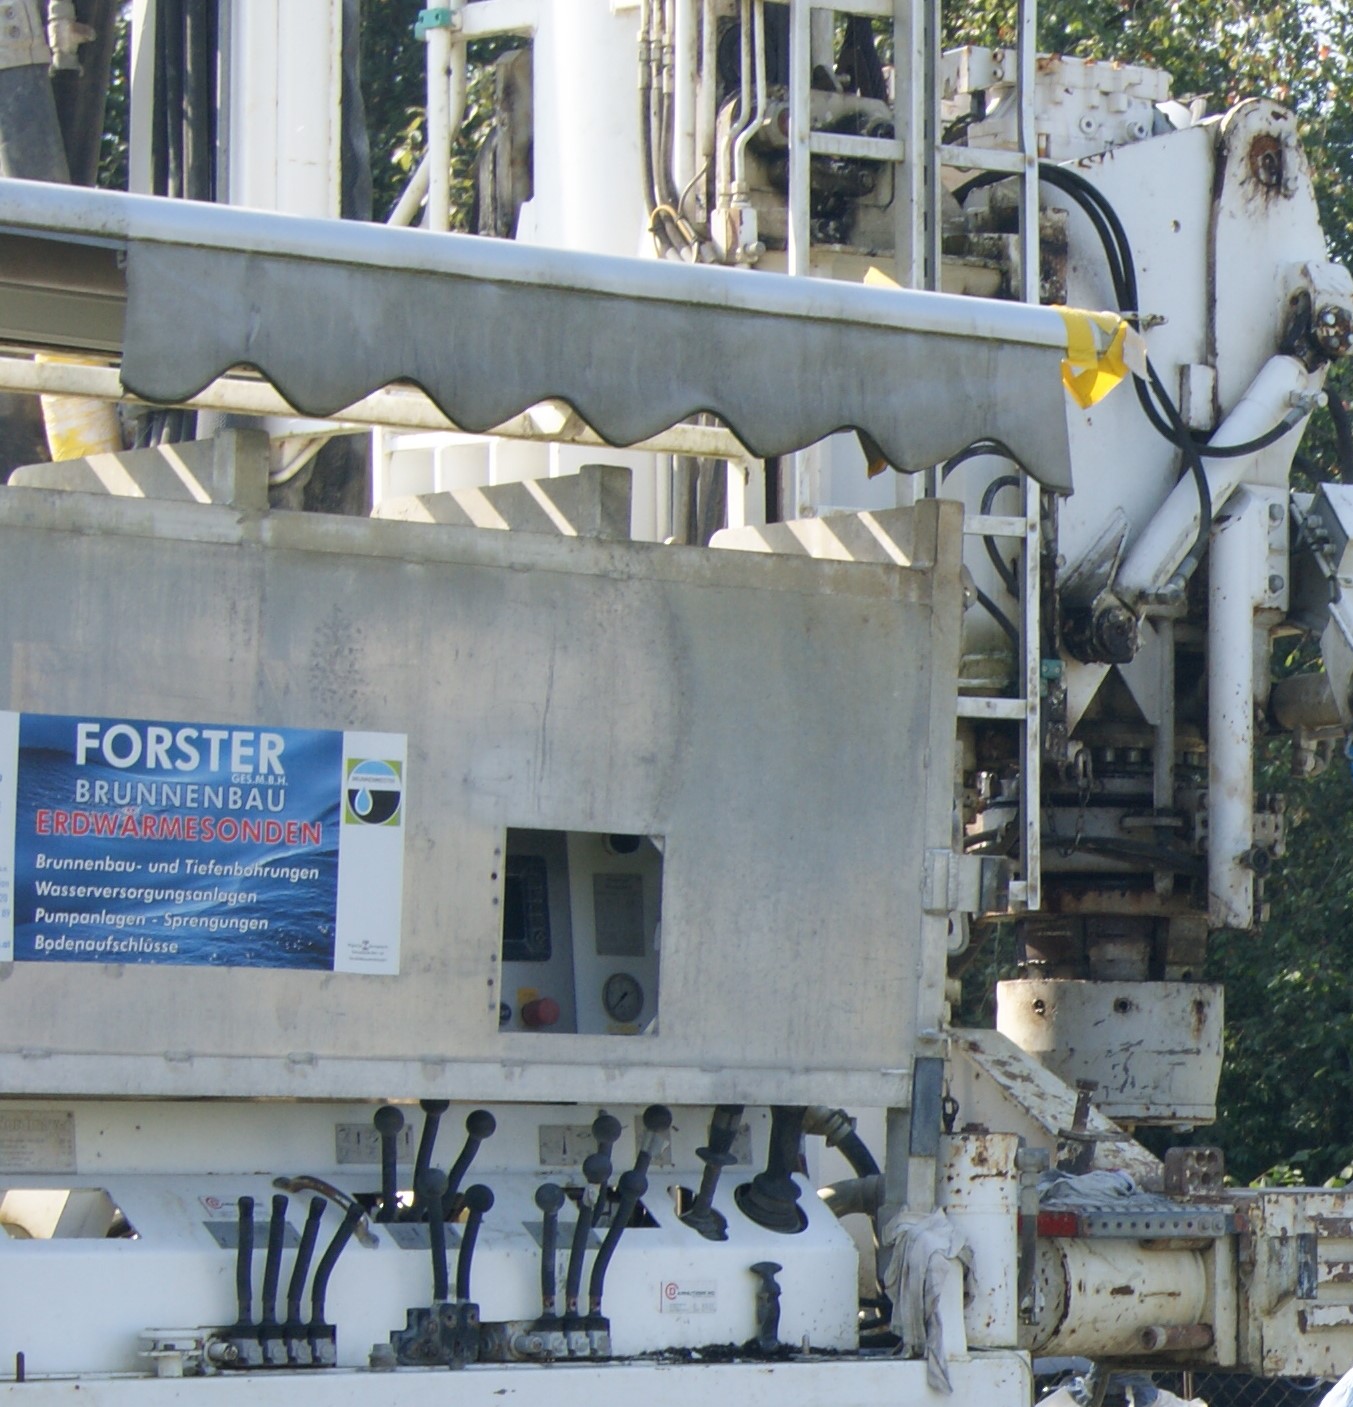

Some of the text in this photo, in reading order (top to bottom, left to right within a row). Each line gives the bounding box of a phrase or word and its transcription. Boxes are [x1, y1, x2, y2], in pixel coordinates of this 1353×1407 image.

[75, 722, 286, 775] FORSTER
[231, 773, 289, 787] GES.M.B.H.
[75, 779, 286, 812] BRUNNENBAU
[35, 807, 323, 846] ERDWÄRMESONDEN
[35, 854, 320, 882] Brunnenbau- und Tiefenbohrungen
[35, 881, 257, 903] Wasserversorgungsanlagen
[35, 908, 146, 928] Pumpanlagen
[164, 912, 269, 931] Sprengungen
[34, 935, 179, 953] Bodenaufschlüsse
